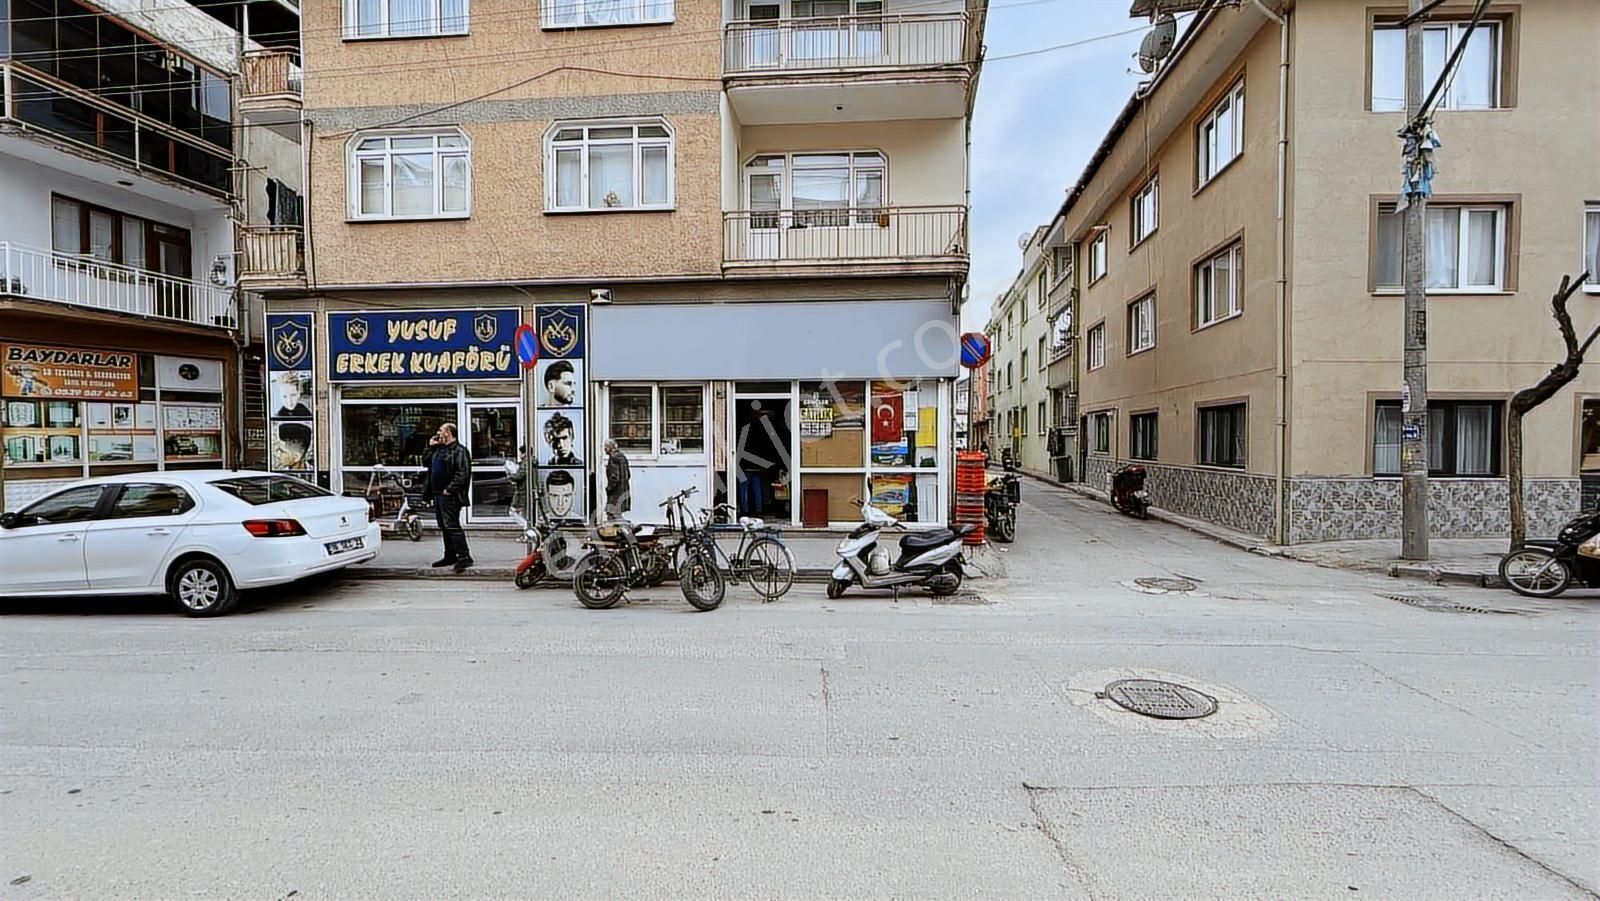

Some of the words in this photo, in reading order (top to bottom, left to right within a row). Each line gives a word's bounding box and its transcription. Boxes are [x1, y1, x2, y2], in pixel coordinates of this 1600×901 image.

[387, 318, 457, 343] YUSUF
[8, 347, 132, 367] BAYDARLAR
[336, 351, 405, 374] ERKEK
[410, 344, 511, 374] KUAFÖRÜ
